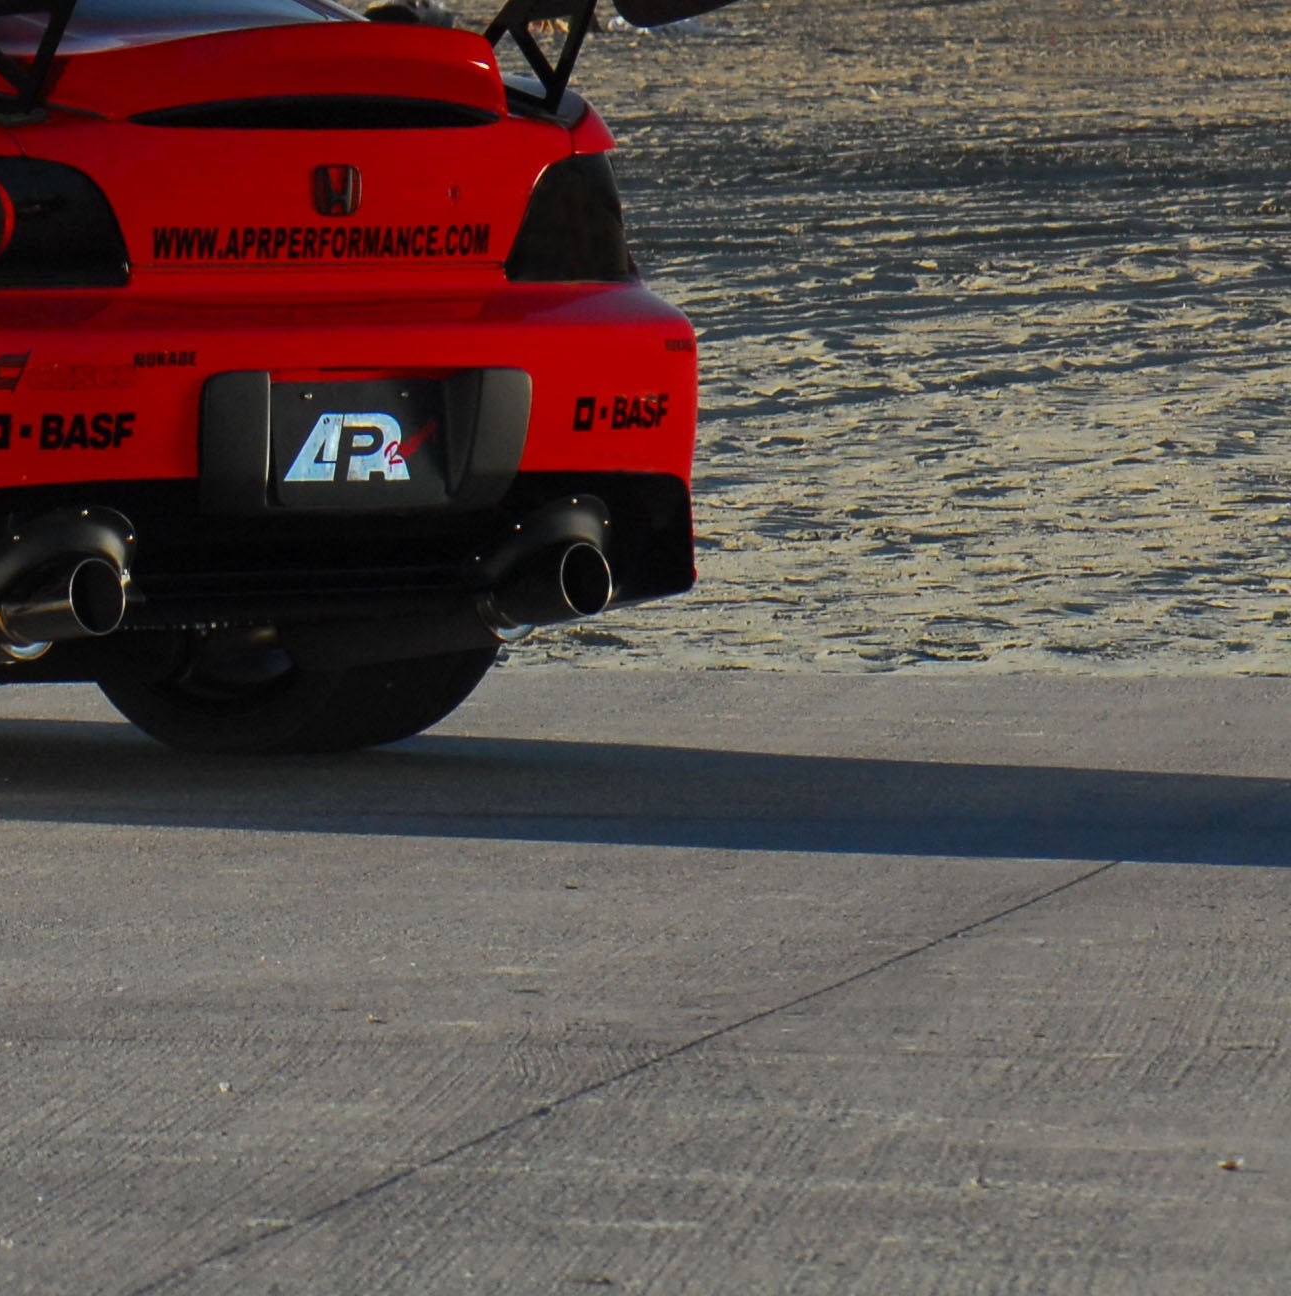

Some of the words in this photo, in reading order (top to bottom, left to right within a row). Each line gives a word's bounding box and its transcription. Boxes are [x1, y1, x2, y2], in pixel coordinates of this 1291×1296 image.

[152, 224, 490, 260] WWW.APRPERFORMANCE.COM
[38, 411, 137, 451] BASF
[610, 393, 670, 431] BASF
